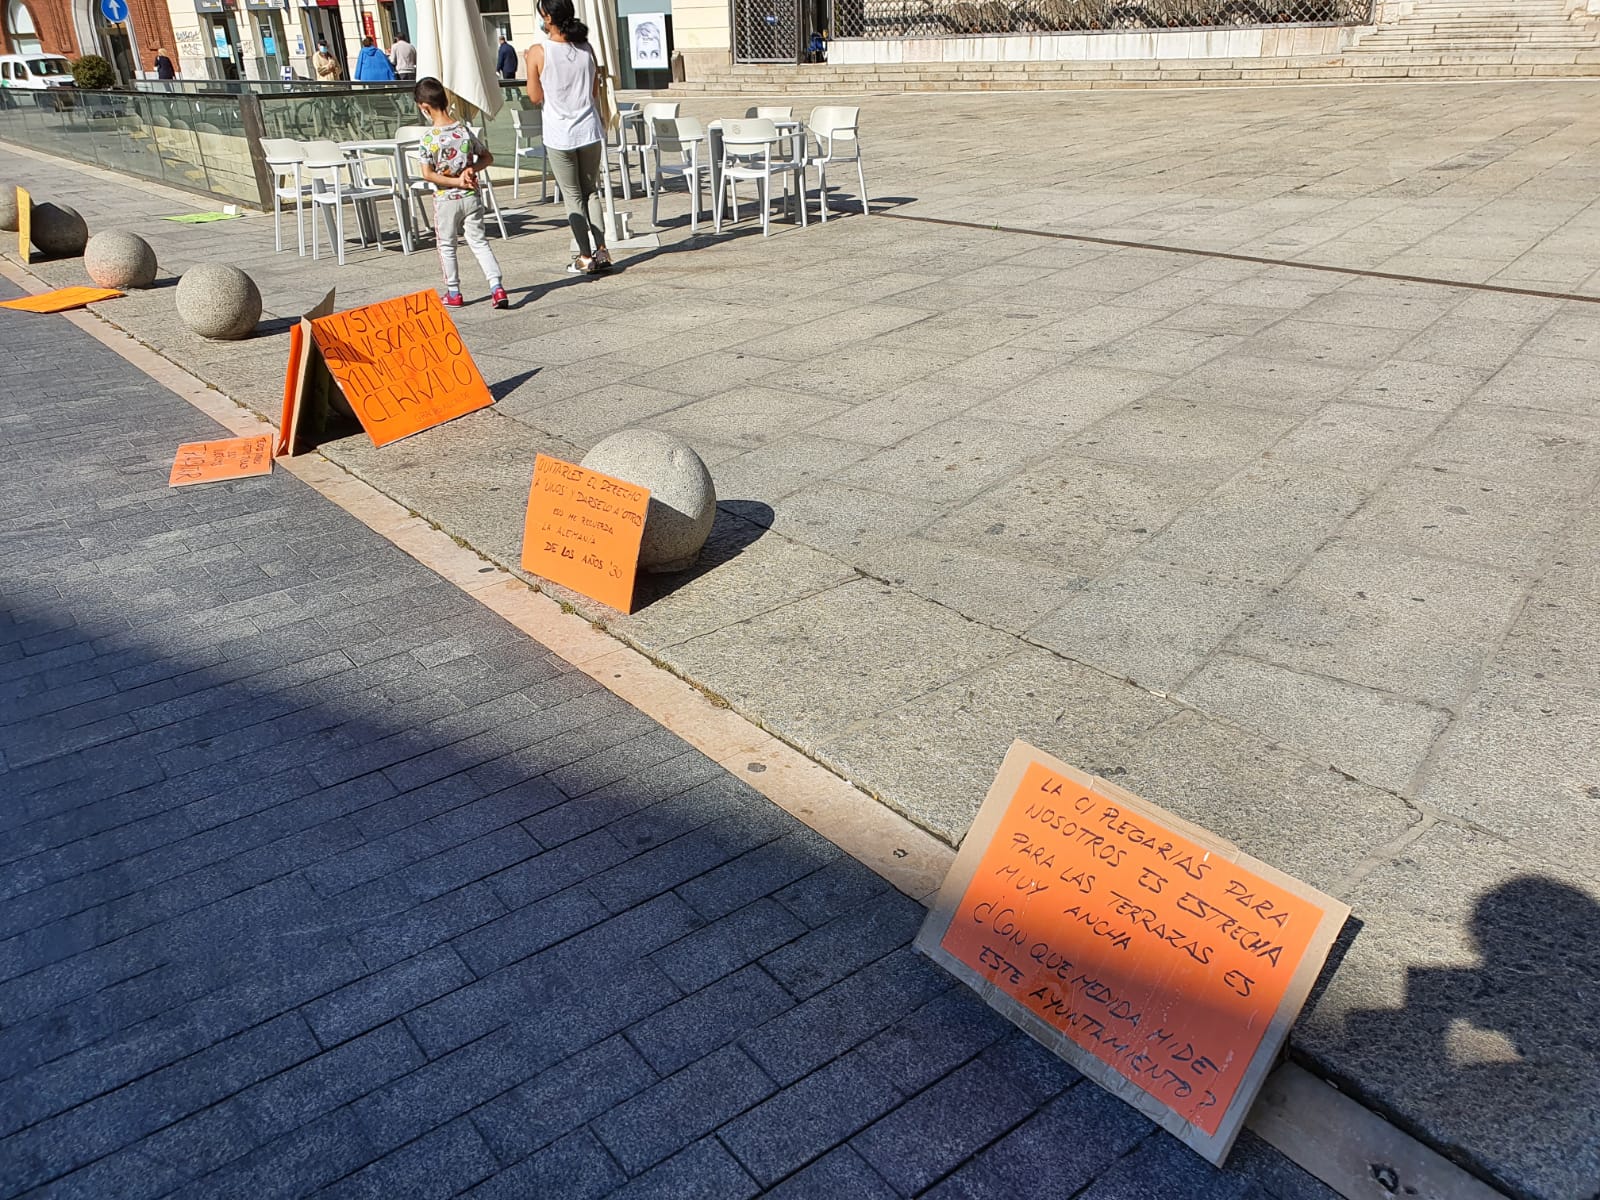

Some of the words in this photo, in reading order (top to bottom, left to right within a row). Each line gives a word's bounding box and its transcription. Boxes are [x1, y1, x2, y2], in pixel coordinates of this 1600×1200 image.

[363, 359, 472, 422] CERRADO
[371, 332, 462, 386] MERCADO
[586, 476, 596, 490] EL
[600, 479, 642, 502] DERECHO
[543, 541, 559, 553] DE
[560, 546, 575, 560] LOS
[581, 553, 604, 570] AÑOS
[568, 513, 577, 522] ME
[582, 516, 614, 535] RECUERDA
[1040, 777, 1063, 797] LA
[1074, 796, 1094, 814] C/
[1098, 807, 1212, 881] PLEGARIAS
[1224, 879, 1290, 928] PARA
[995, 866, 1050, 896] MUY
[1063, 905, 1133, 951] ANCHA
[1011, 832, 1056, 869] PARA
[1059, 866, 1097, 895] LAS
[1107, 890, 1215, 965] TERRAZAS
[1223, 969, 1256, 997] ES
[1025, 803, 1127, 868] NOSOTROS
[1138, 866, 1169, 894] ES
[1176, 891, 1283, 968] ESTRECHA
[979, 945, 1025, 985] ESTE
[1029, 942, 1073, 980] QUE
[1070, 974, 1143, 1028] MEDIDA
[1146, 1028, 1220, 1075] MIDE
